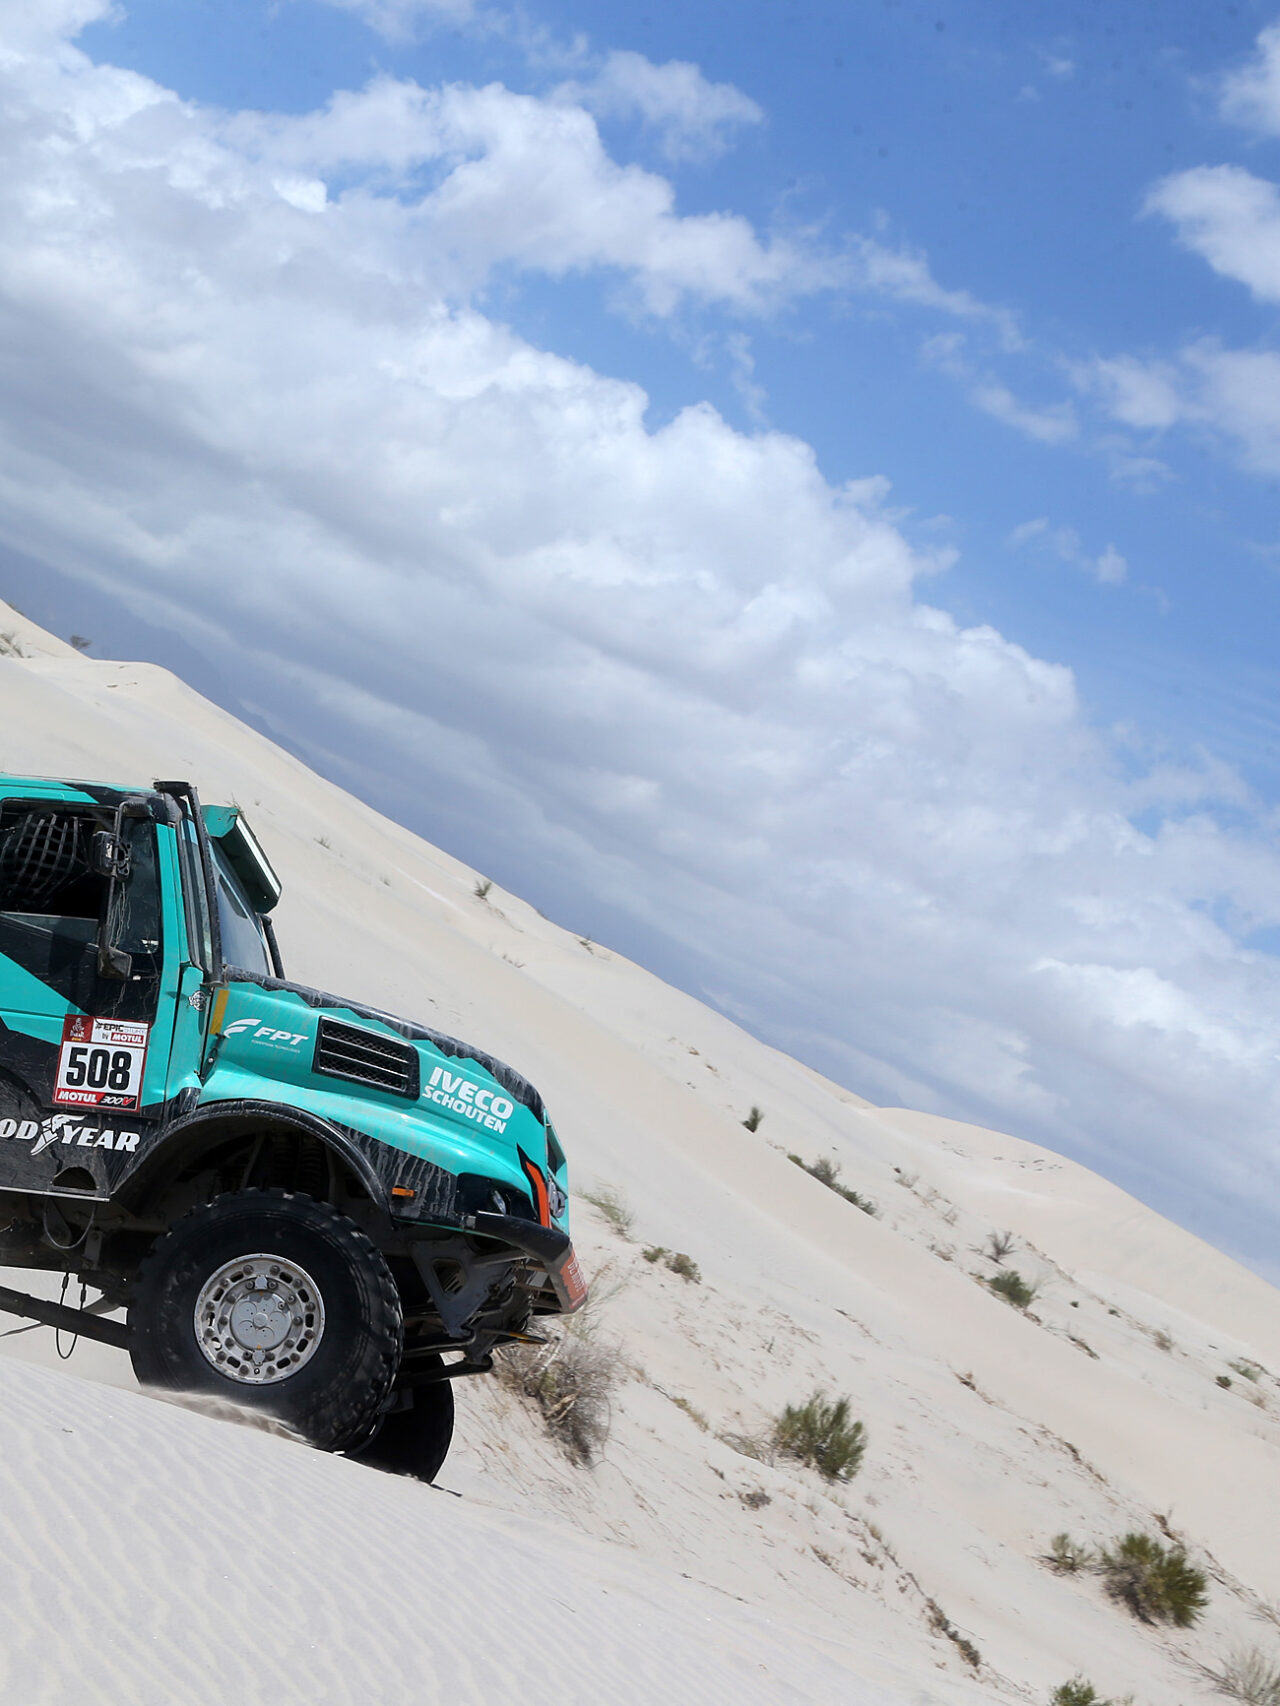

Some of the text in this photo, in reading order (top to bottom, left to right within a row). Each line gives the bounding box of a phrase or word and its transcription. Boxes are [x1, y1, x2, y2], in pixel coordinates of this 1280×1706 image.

[111, 1033, 142, 1043] MOTUL
[253, 1026, 309, 1047] FPT
[66, 1047, 132, 1091] 508
[57, 1090, 135, 1106] MOTUL 300V
[422, 1085, 507, 1134] SCHOUTEN
[428, 1066, 514, 1121] IVECO
